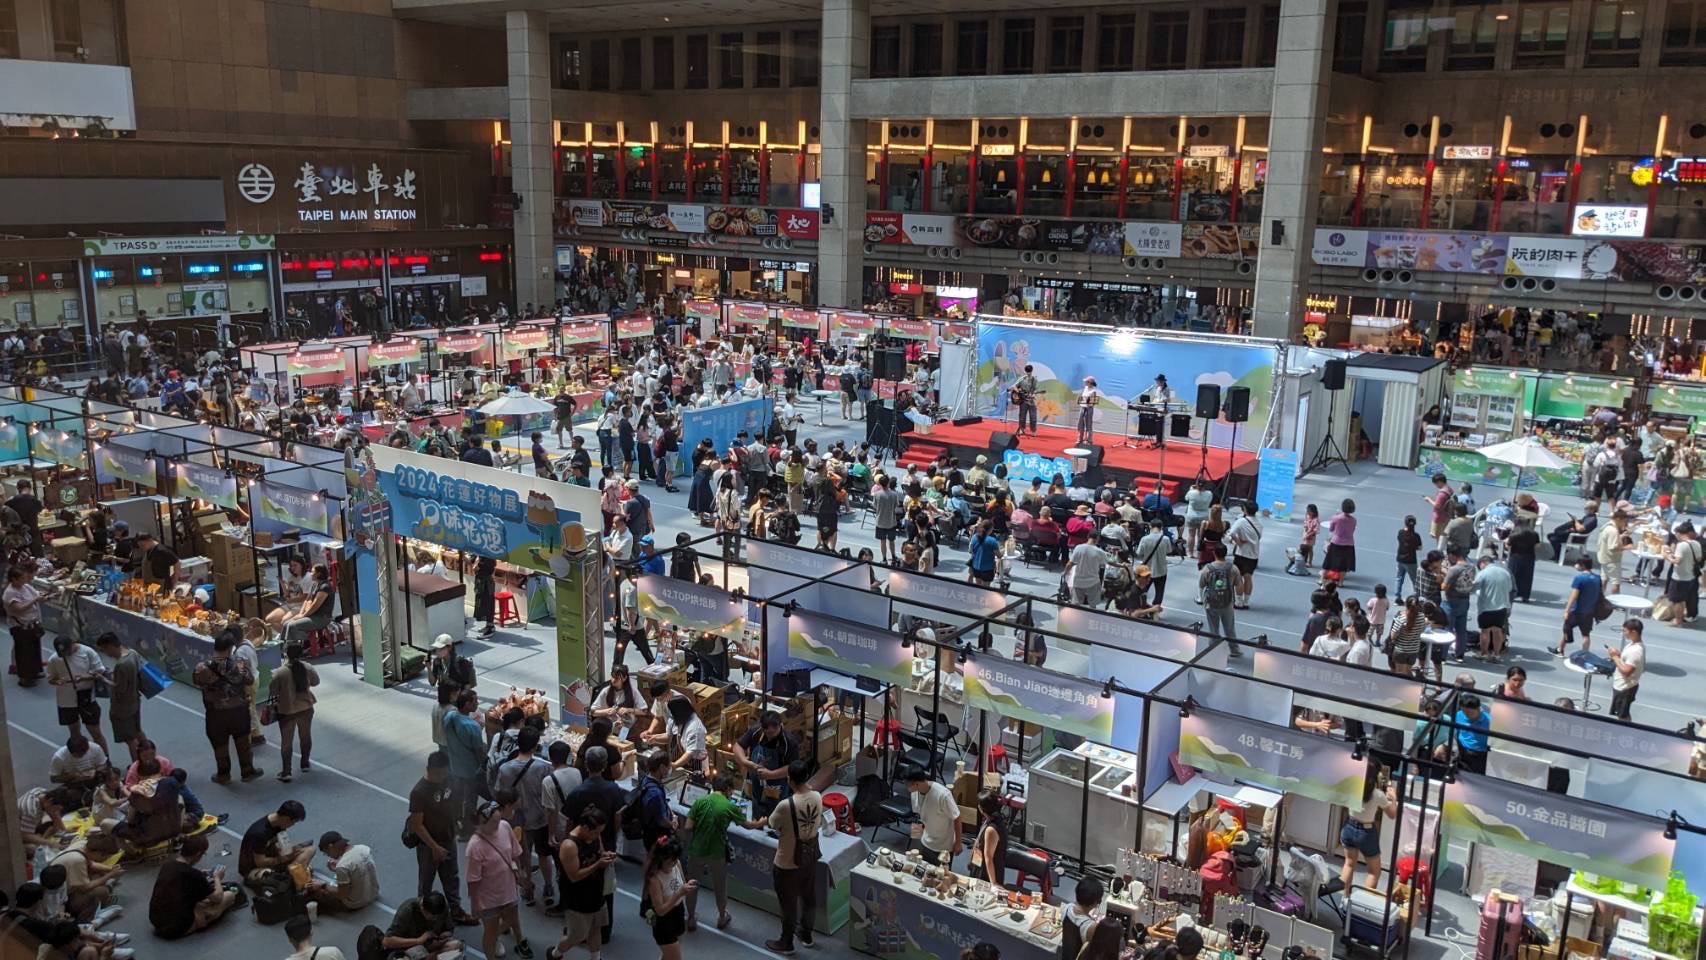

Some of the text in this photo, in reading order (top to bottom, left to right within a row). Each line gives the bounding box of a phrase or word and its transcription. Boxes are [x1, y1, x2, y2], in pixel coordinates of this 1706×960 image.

[294, 162, 416, 205] 臺北車站
[298, 209, 416, 221] TAIPEI MAIN STATION
[113, 241, 148, 250] TPASS
[1511, 247, 1578, 262] 阮的肉干
